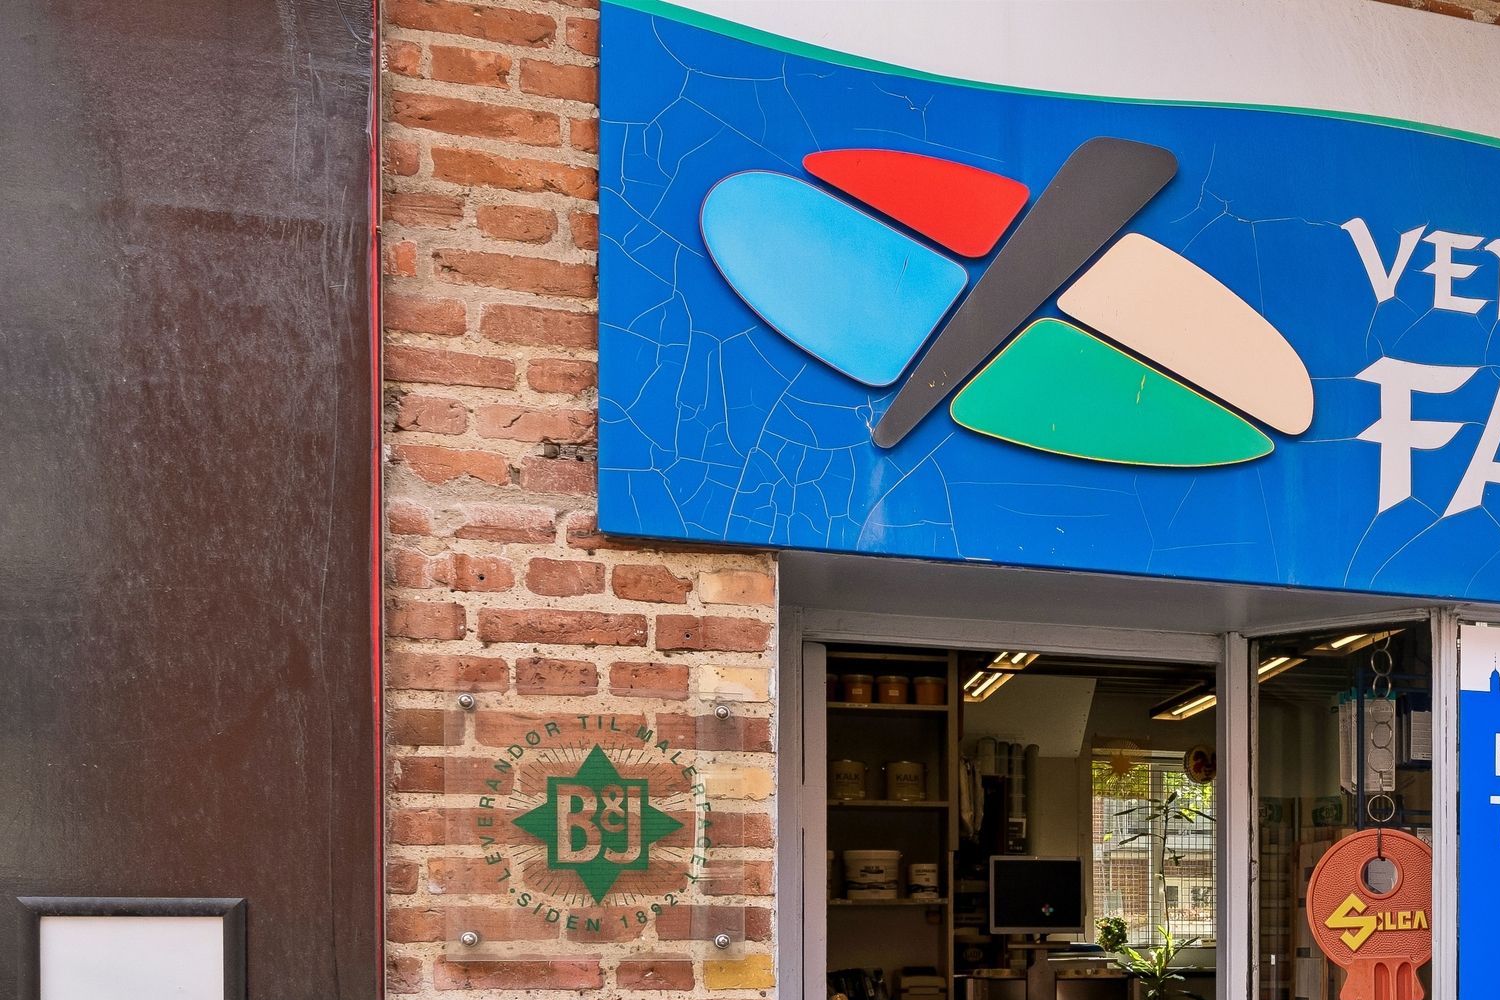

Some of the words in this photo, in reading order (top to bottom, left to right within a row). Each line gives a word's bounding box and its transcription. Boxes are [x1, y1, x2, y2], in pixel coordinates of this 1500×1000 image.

[477, 721, 562, 883] LEVERANDØR
[577, 714, 621, 732] TIL
[637, 725, 713, 884] MALERFAGET
[516, 892, 602, 932] SIDEN
[620, 892, 679, 929] 1892
[1324, 893, 1429, 952] SILCA
